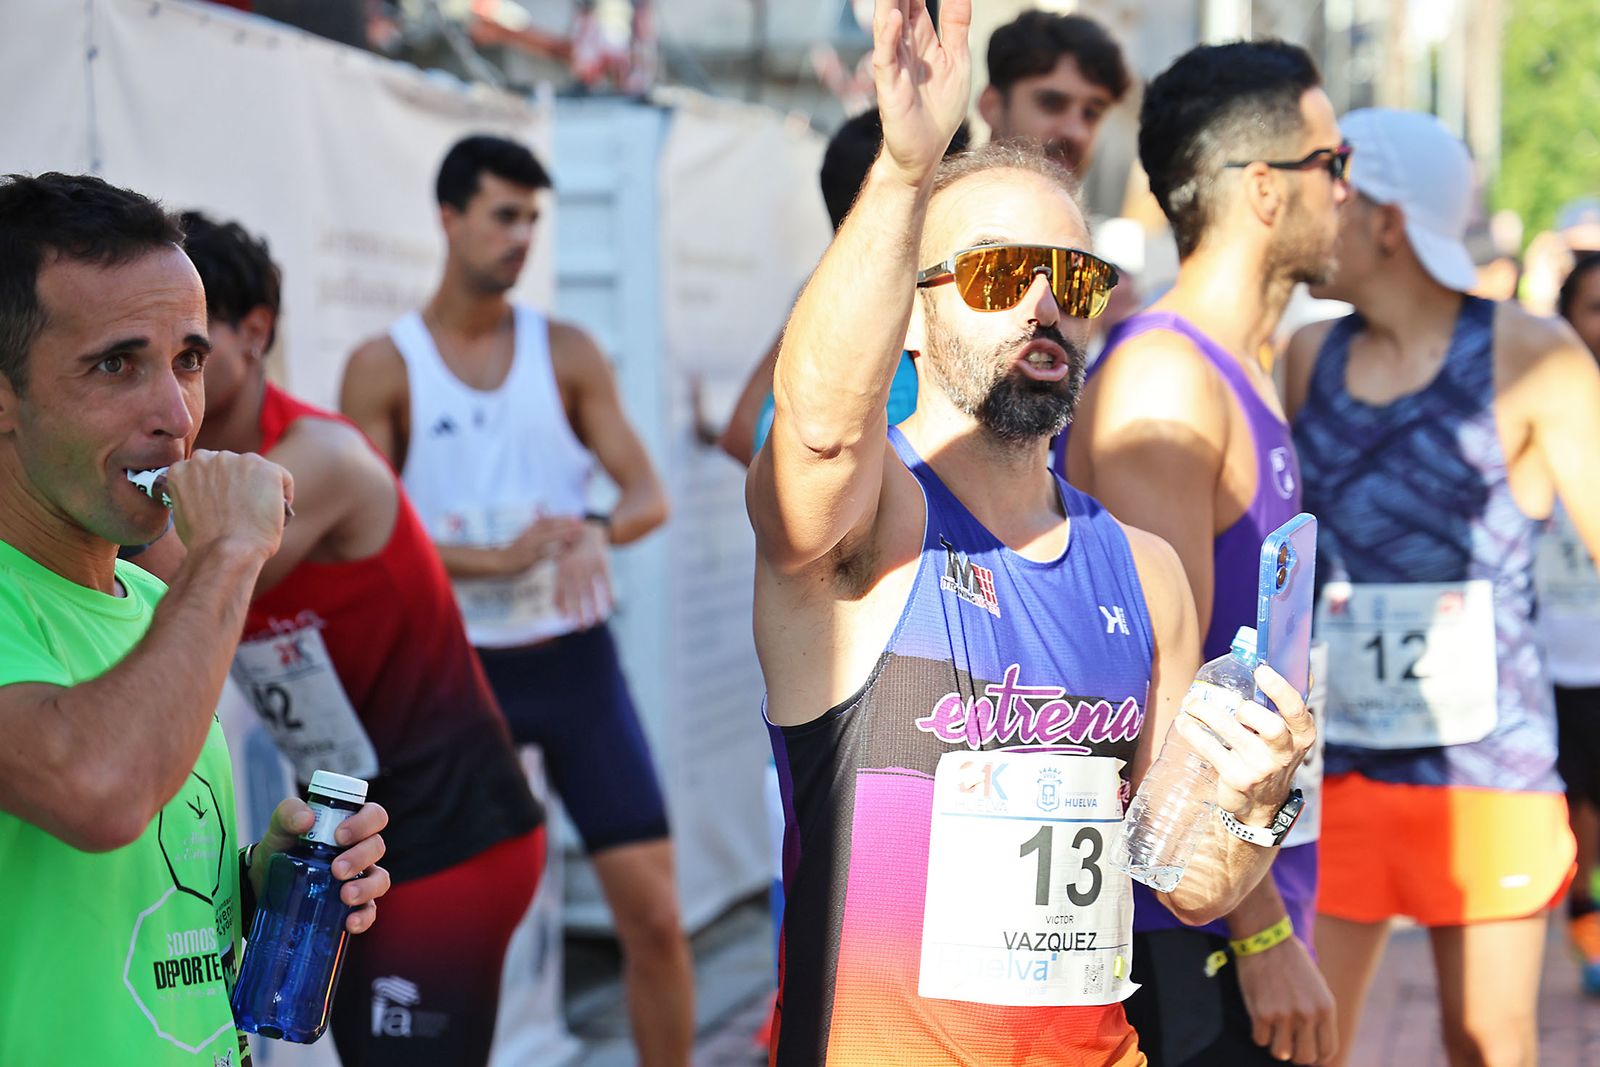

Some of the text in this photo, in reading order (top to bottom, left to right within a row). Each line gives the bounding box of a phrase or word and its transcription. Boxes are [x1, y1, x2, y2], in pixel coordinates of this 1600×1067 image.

[1364, 630, 1432, 682] 12
[916, 664, 1143, 749] entrena
[1065, 798, 1097, 807] HUELVA
[1019, 825, 1104, 907] 13
[1046, 915, 1074, 924] VICTOR
[1003, 931, 1097, 952] VAZQUEZ
[154, 952, 222, 989] DEPORTE
